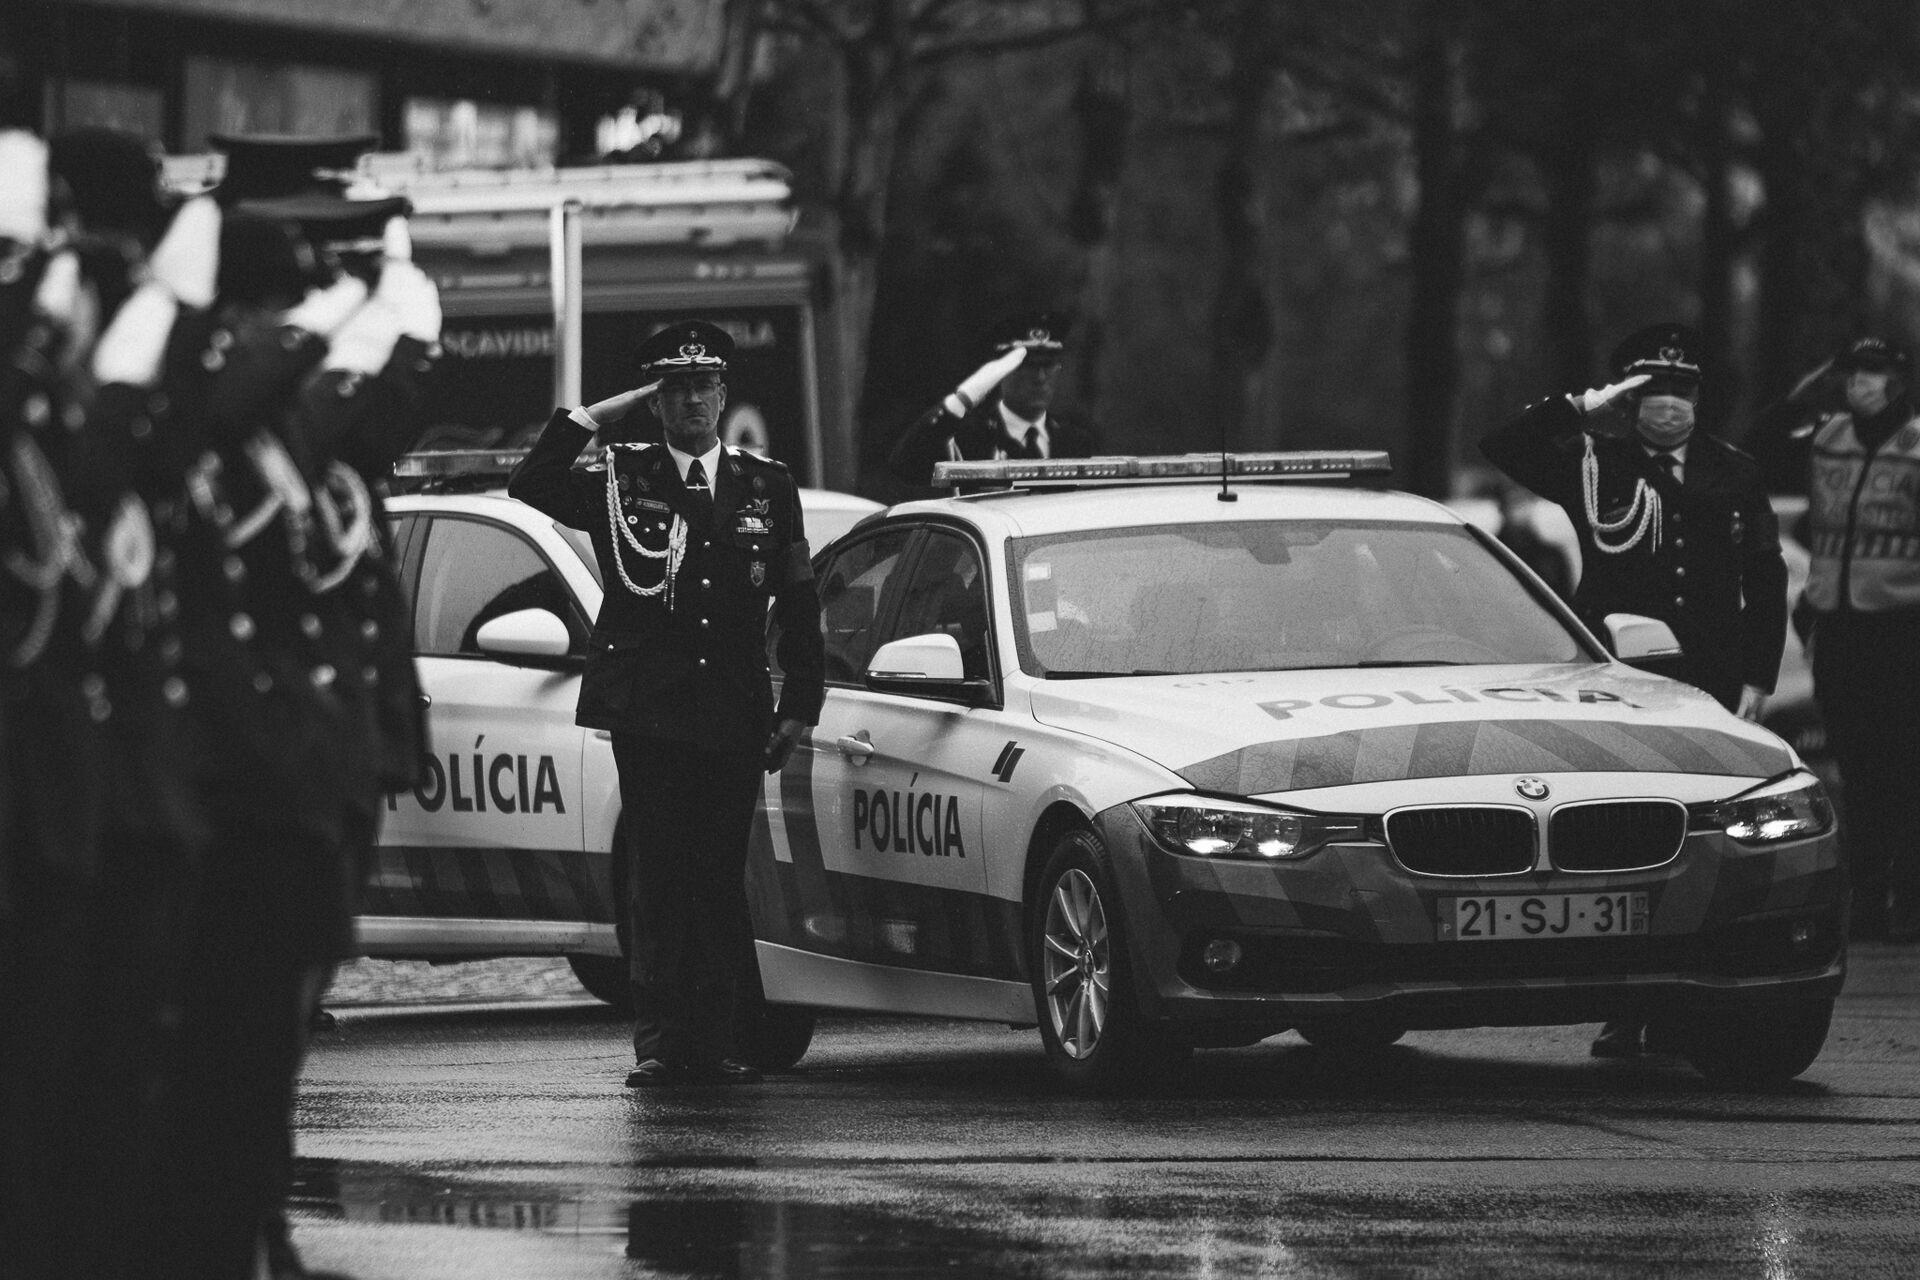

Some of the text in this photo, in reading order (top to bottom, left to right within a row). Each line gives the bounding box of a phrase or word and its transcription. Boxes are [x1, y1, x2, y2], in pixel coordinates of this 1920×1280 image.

[1257, 684, 1646, 720] POLÍCIA
[386, 734, 566, 814] OLÍCIA
[854, 772, 966, 858] POLÍCIA
